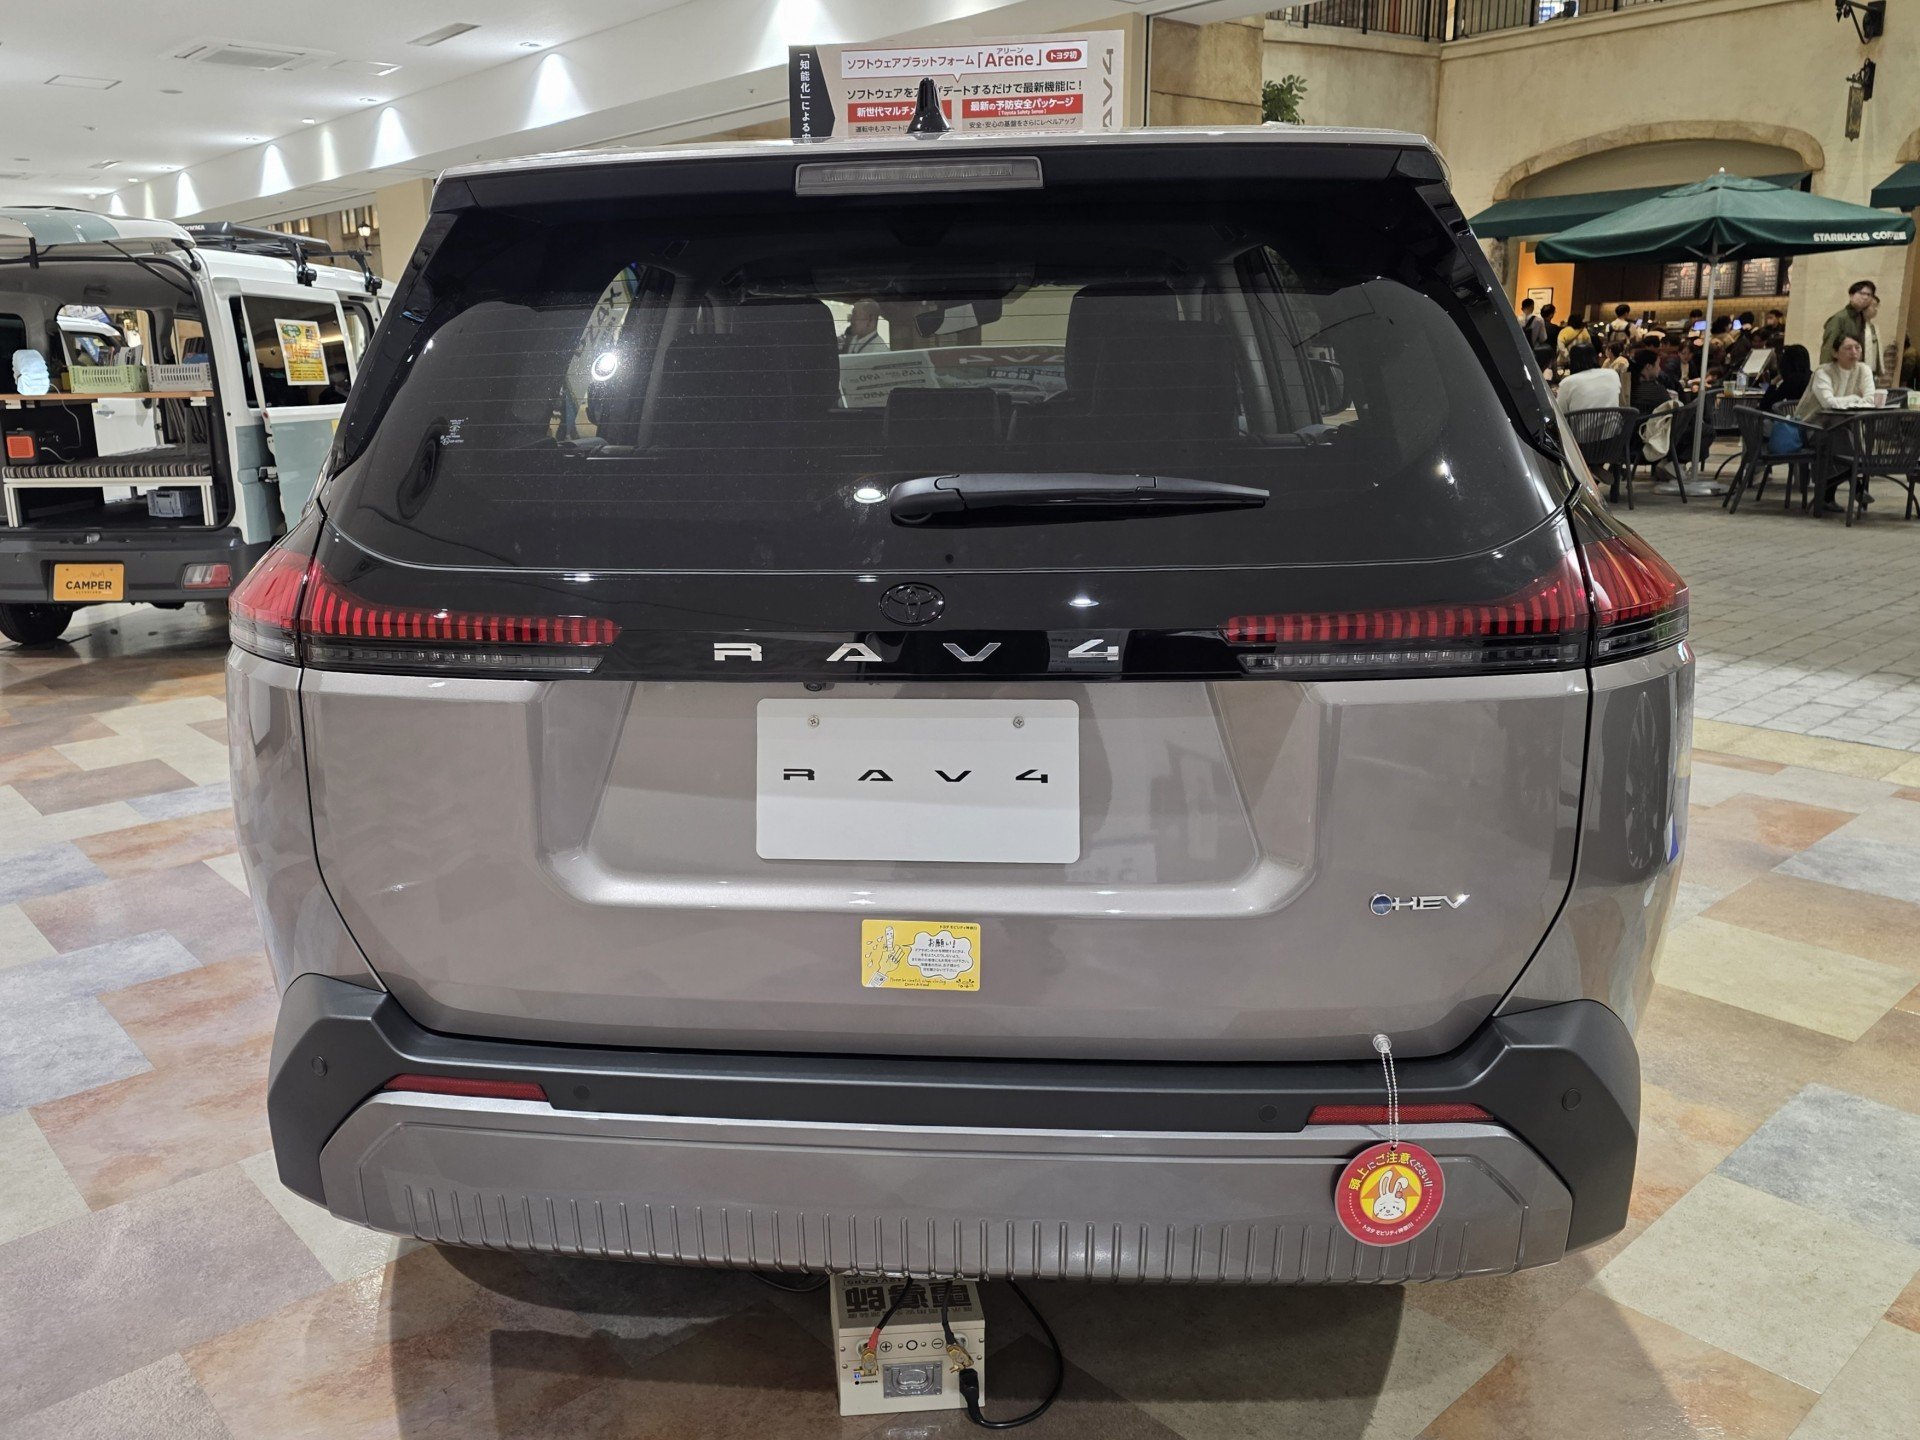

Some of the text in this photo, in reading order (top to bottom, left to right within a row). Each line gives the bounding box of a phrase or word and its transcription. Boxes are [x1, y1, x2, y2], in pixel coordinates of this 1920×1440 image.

[1050, 52, 1077, 60] トヨタ初
[970, 97, 1075, 111] 最新の予防安全パッケージ
[1813, 231, 1870, 243] STARBUCKS
[65, 581, 112, 590] CAMPER
[1392, 894, 1470, 911] HEV
